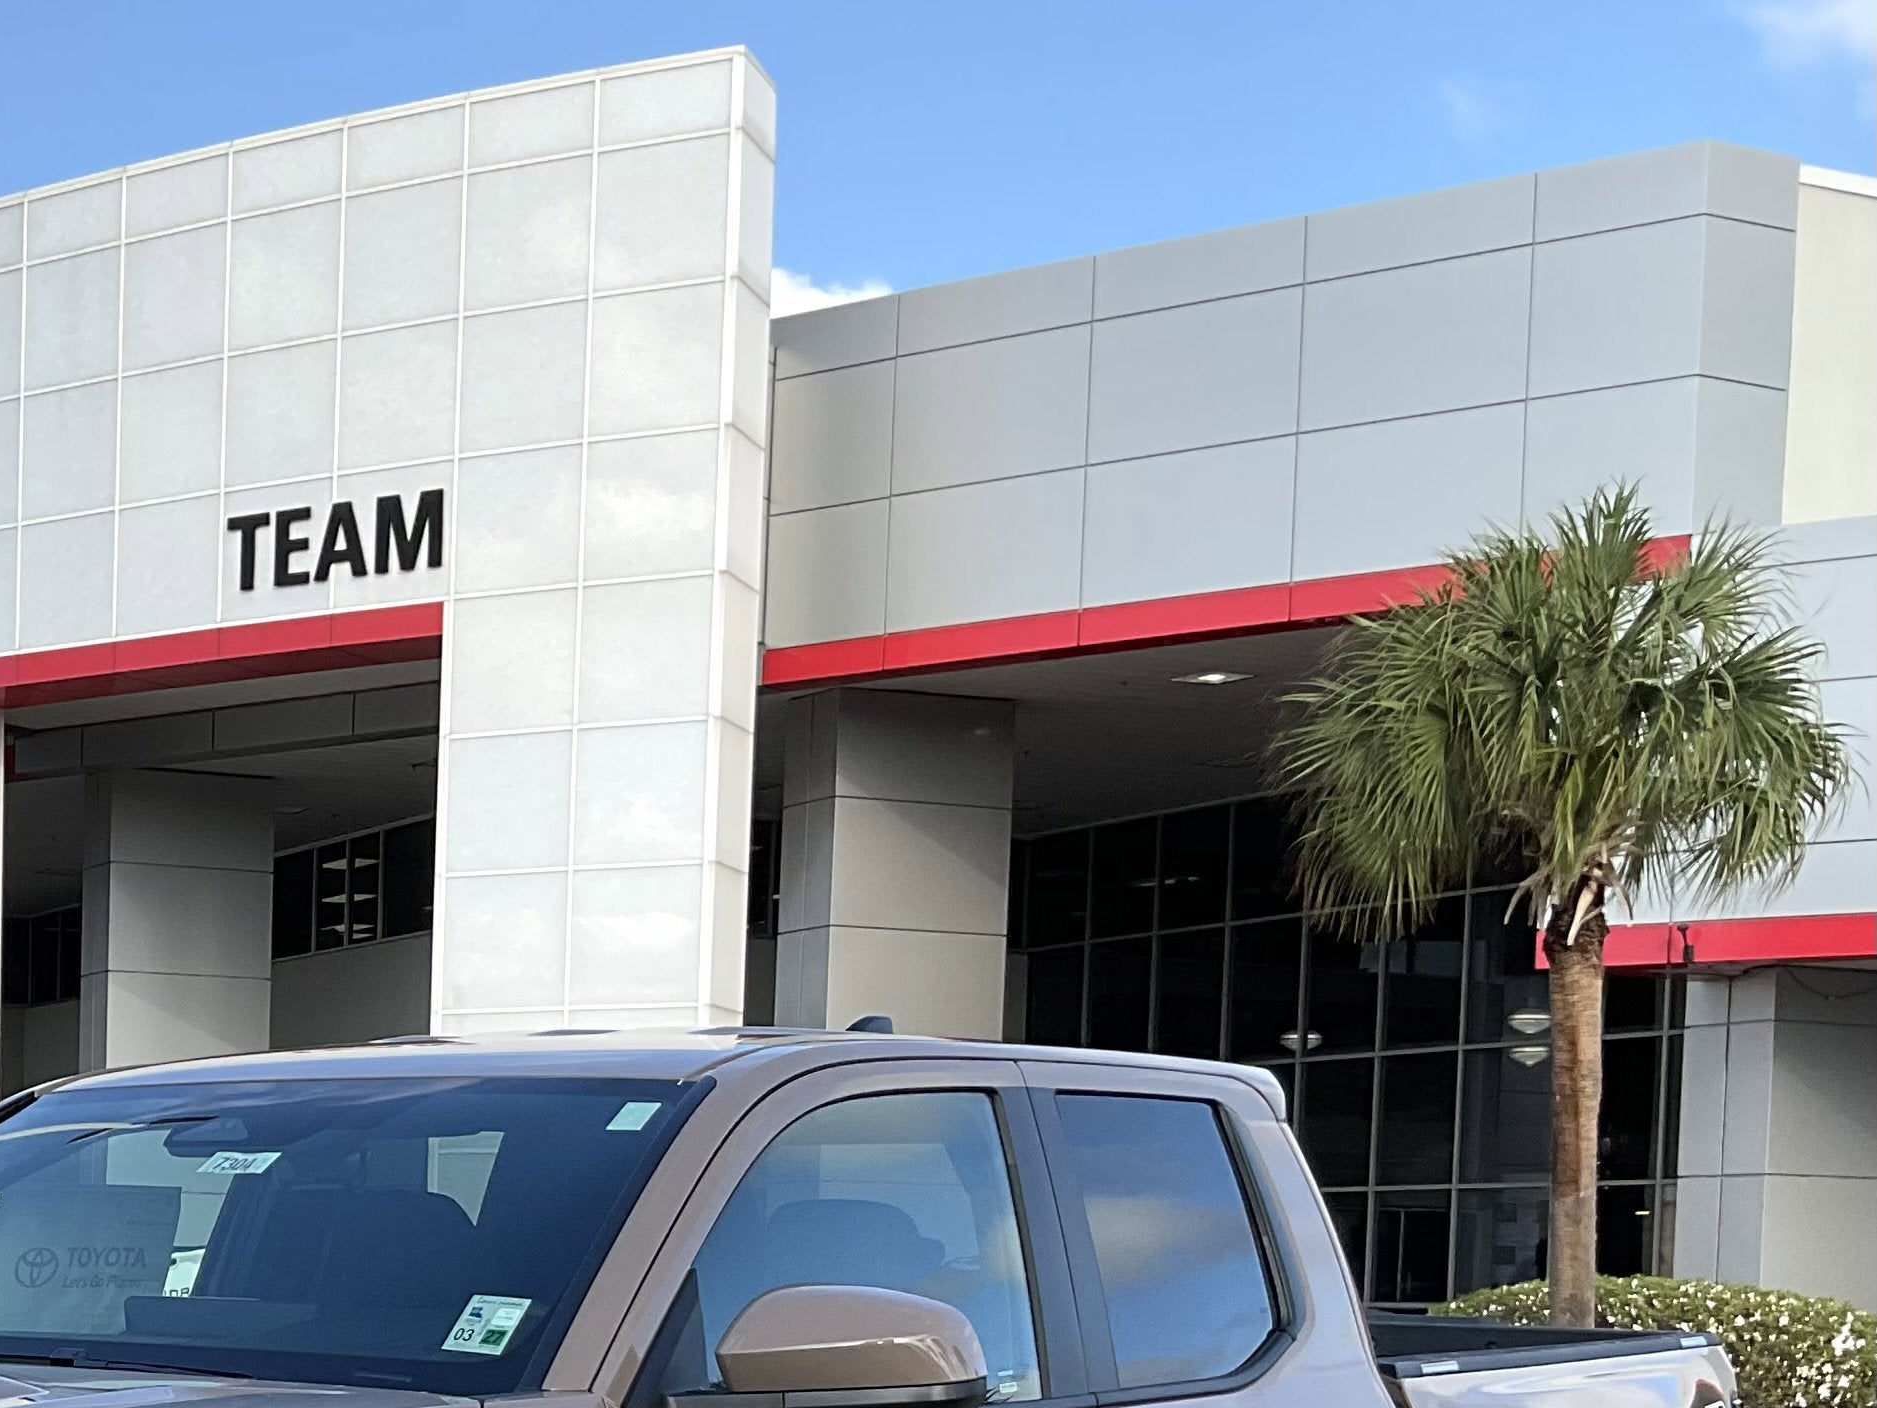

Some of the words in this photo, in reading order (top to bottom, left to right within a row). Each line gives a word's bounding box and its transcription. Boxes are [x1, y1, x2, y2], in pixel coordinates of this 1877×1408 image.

[227, 488, 445, 592] TEAM
[212, 1156, 257, 1172] 7304
[67, 1246, 147, 1268] TOYOTA
[453, 1327, 475, 1341] 03
[484, 1329, 505, 1344] 27
